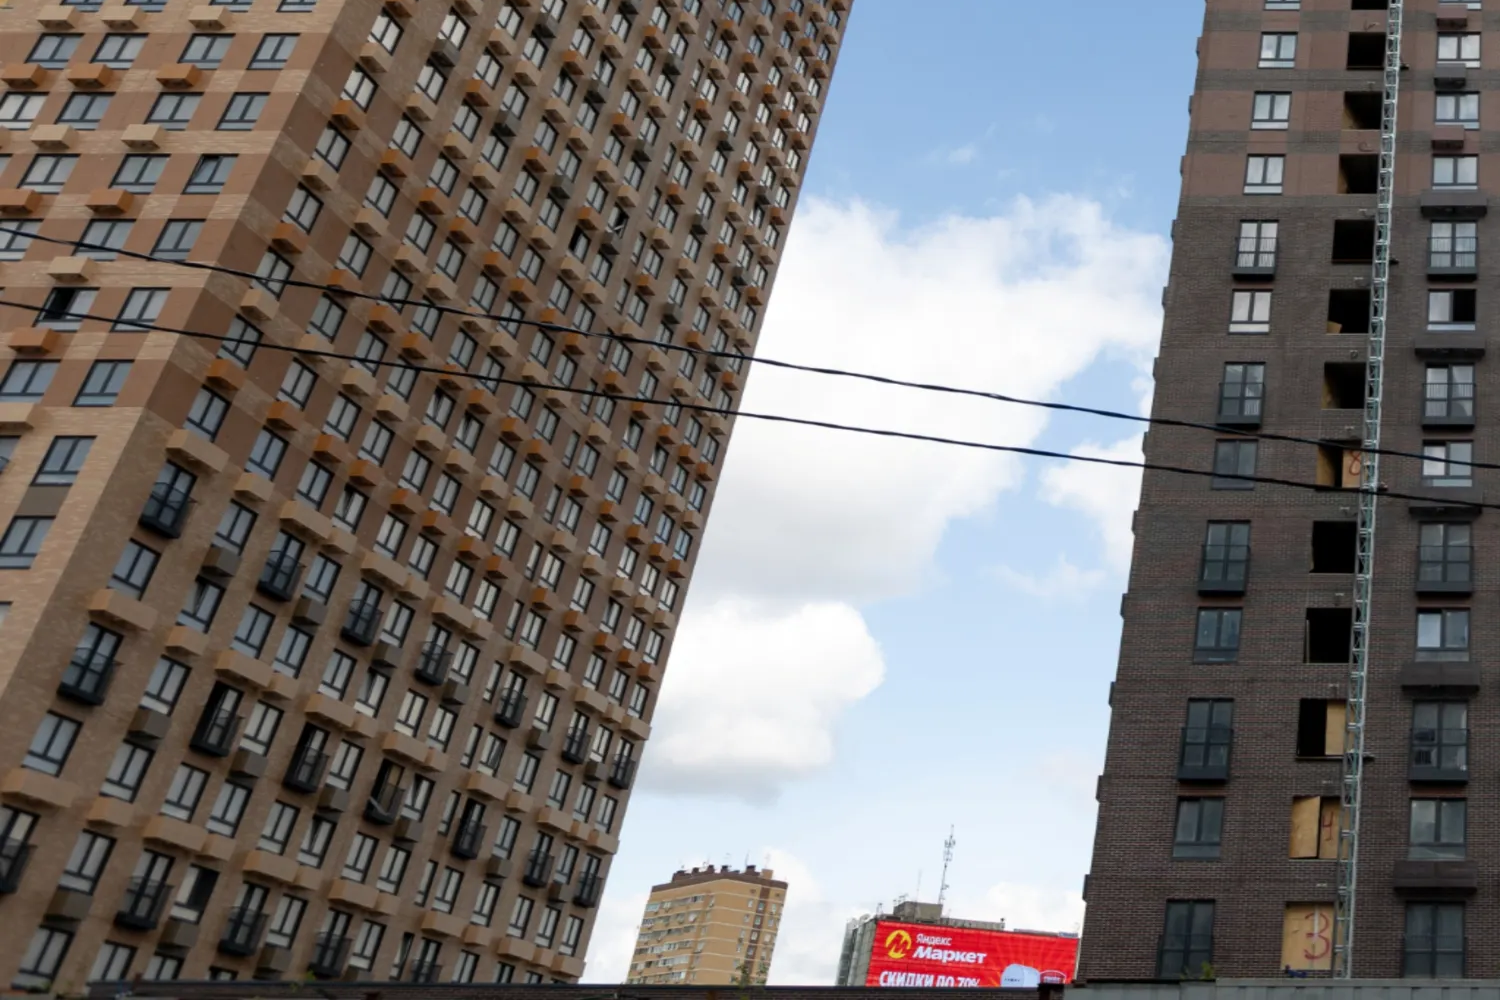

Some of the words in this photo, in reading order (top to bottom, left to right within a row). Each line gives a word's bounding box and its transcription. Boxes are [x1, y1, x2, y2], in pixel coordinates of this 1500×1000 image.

[916, 933, 952, 947] Яндекс
[1304, 911, 1331, 960] 3
[912, 945, 987, 965] Маркет
[880, 971, 934, 987] СКИДКИ
